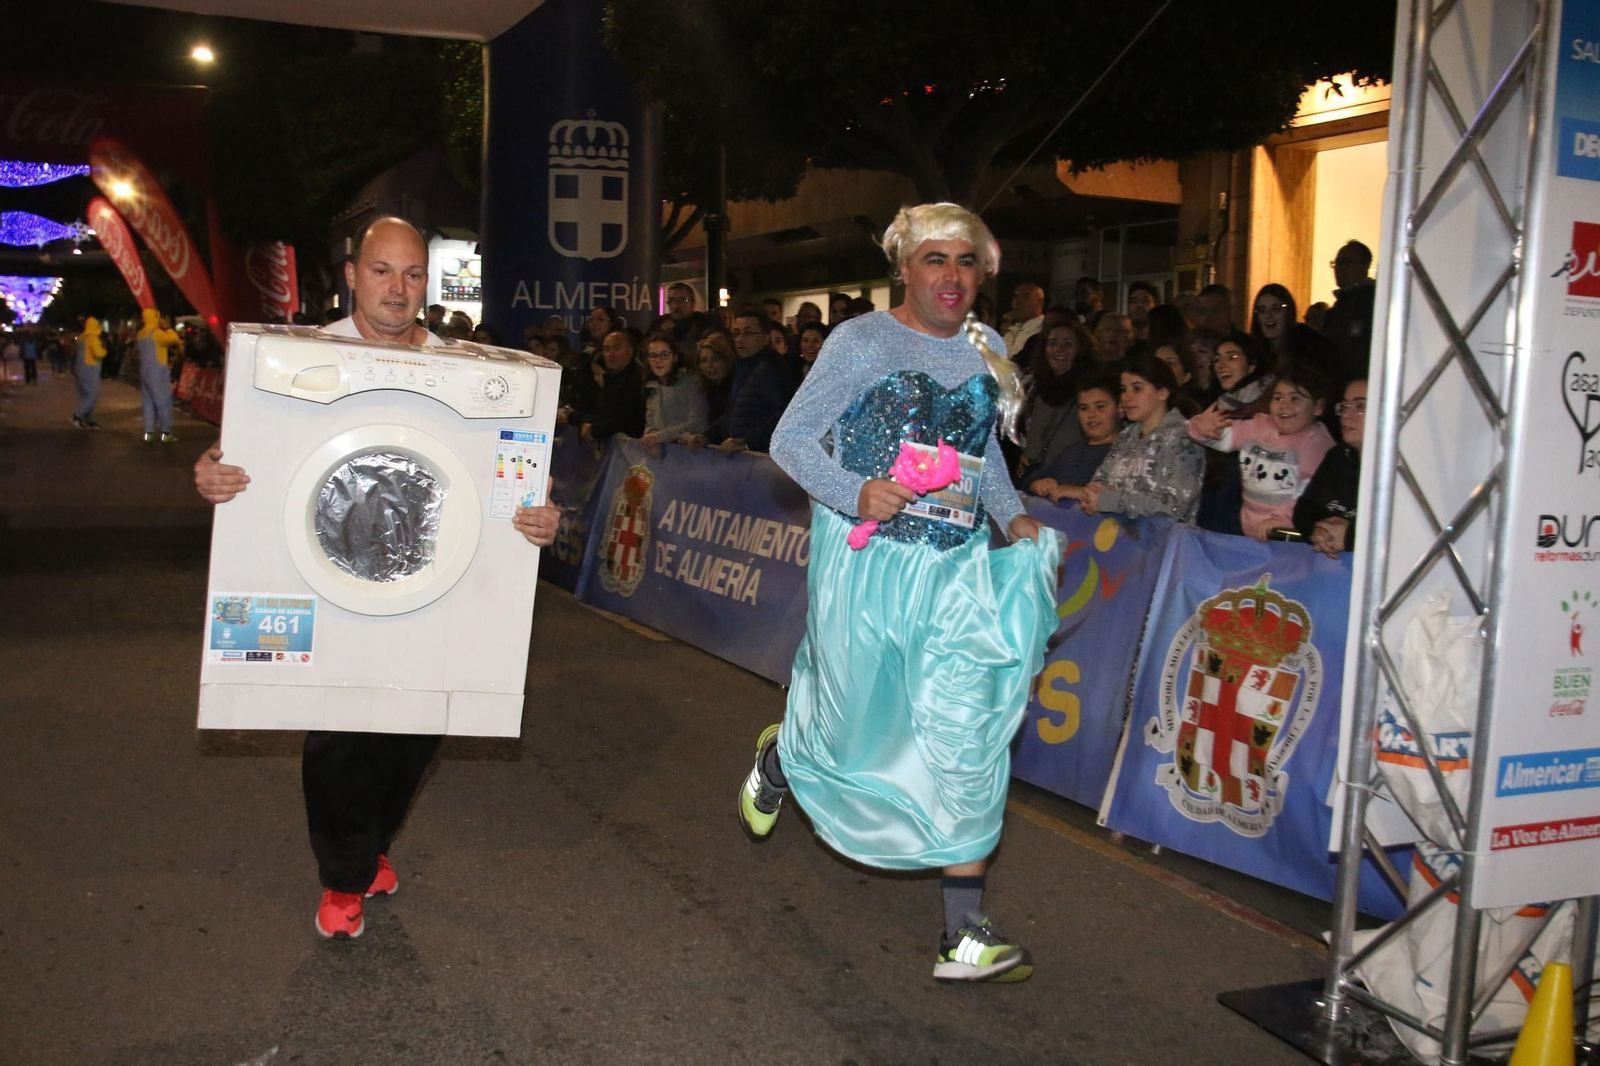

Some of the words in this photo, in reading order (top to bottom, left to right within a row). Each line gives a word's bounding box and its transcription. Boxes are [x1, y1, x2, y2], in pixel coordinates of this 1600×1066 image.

[511, 275, 653, 312] ALMERÍA
[657, 499, 812, 567] AYUNTAMIENTO
[654, 541, 678, 578] DE
[675, 549, 762, 606] ALMERÍA
[258, 615, 300, 634] 461
[1553, 674, 1592, 690] BUEN
[1501, 758, 1584, 790] Almericar
[1181, 799, 1213, 816] CIUDAD
[1215, 806, 1225, 816] DE
[1492, 832, 1511, 847] La
[1511, 829, 1538, 845] Voz
[1539, 826, 1558, 842] de
